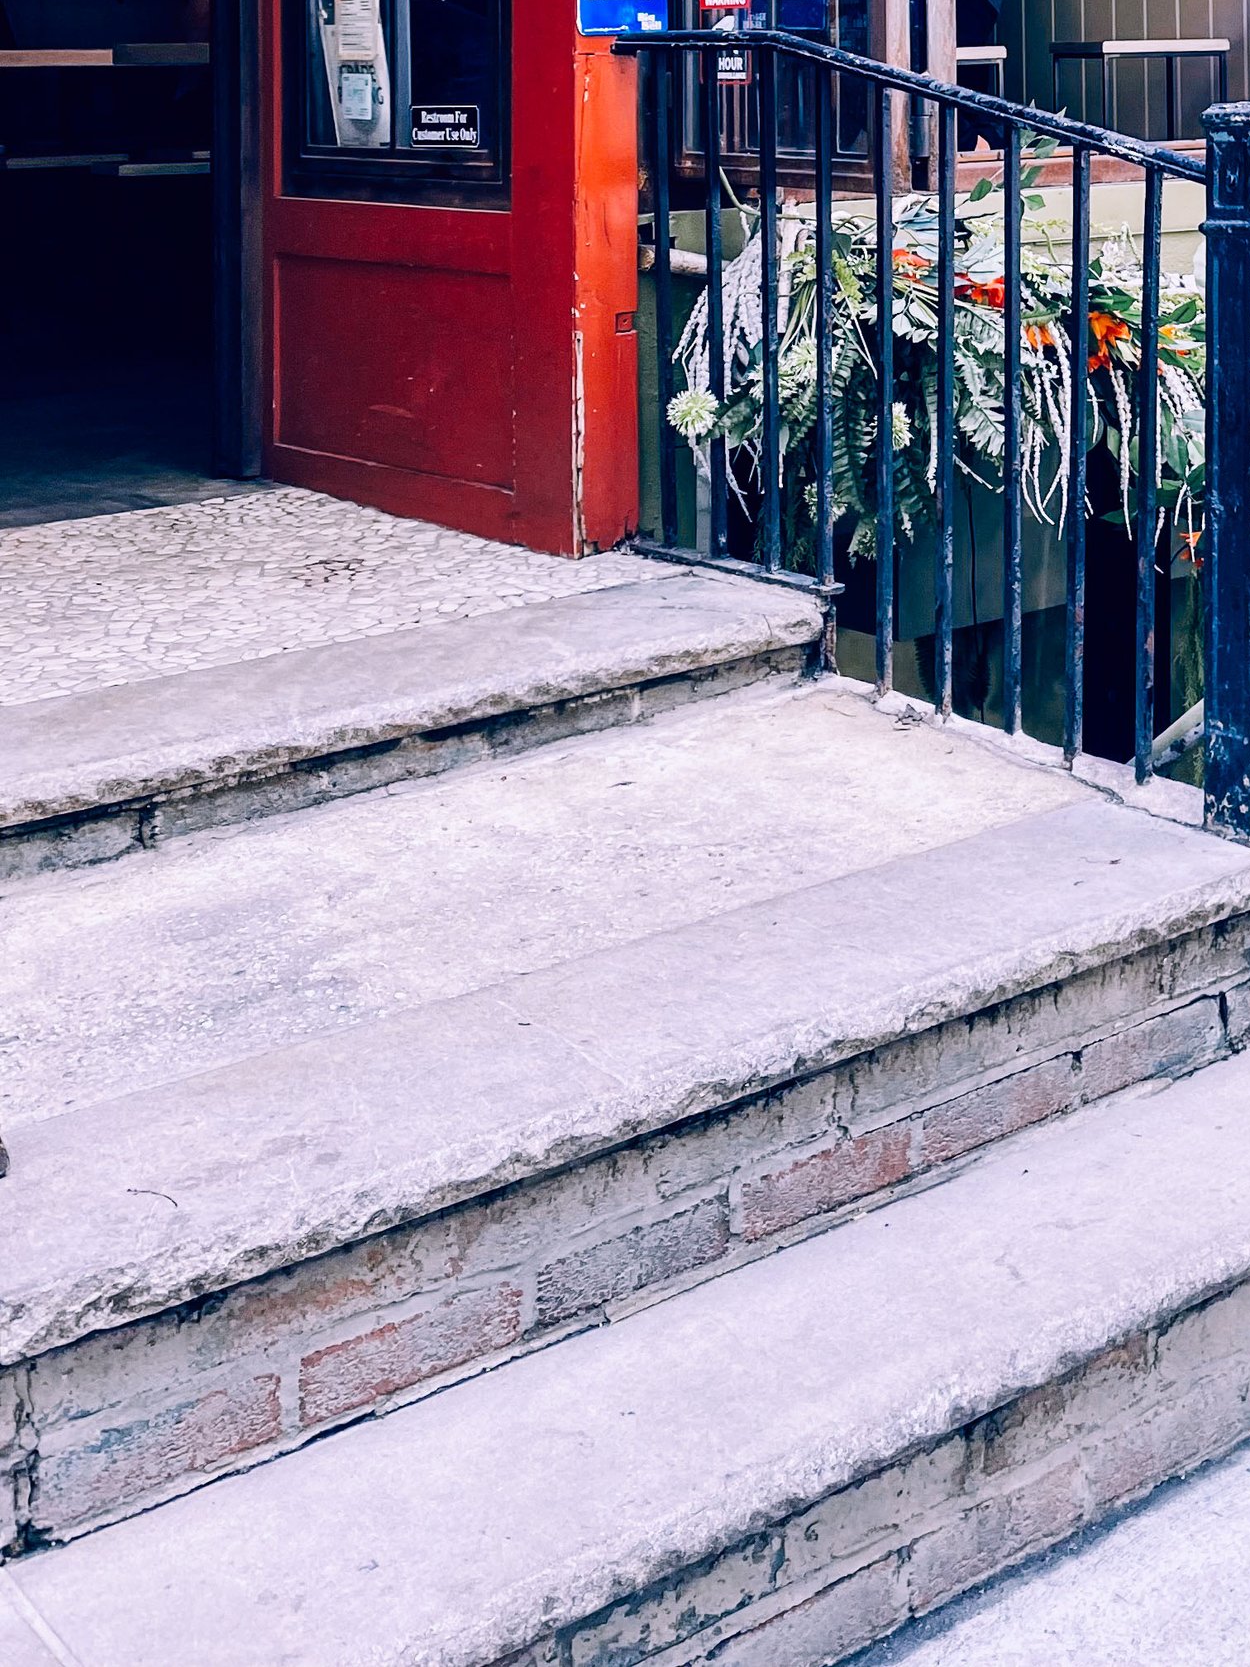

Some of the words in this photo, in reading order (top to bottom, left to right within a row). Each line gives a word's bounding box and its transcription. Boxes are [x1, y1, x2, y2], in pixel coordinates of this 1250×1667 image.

[718, 57, 743, 71] HOUR
[421, 110, 455, 124] Restroom
[455, 110, 468, 124] For
[412, 127, 446, 141] Customer
[446, 127, 460, 141] Use
[460, 127, 477, 144] Only
